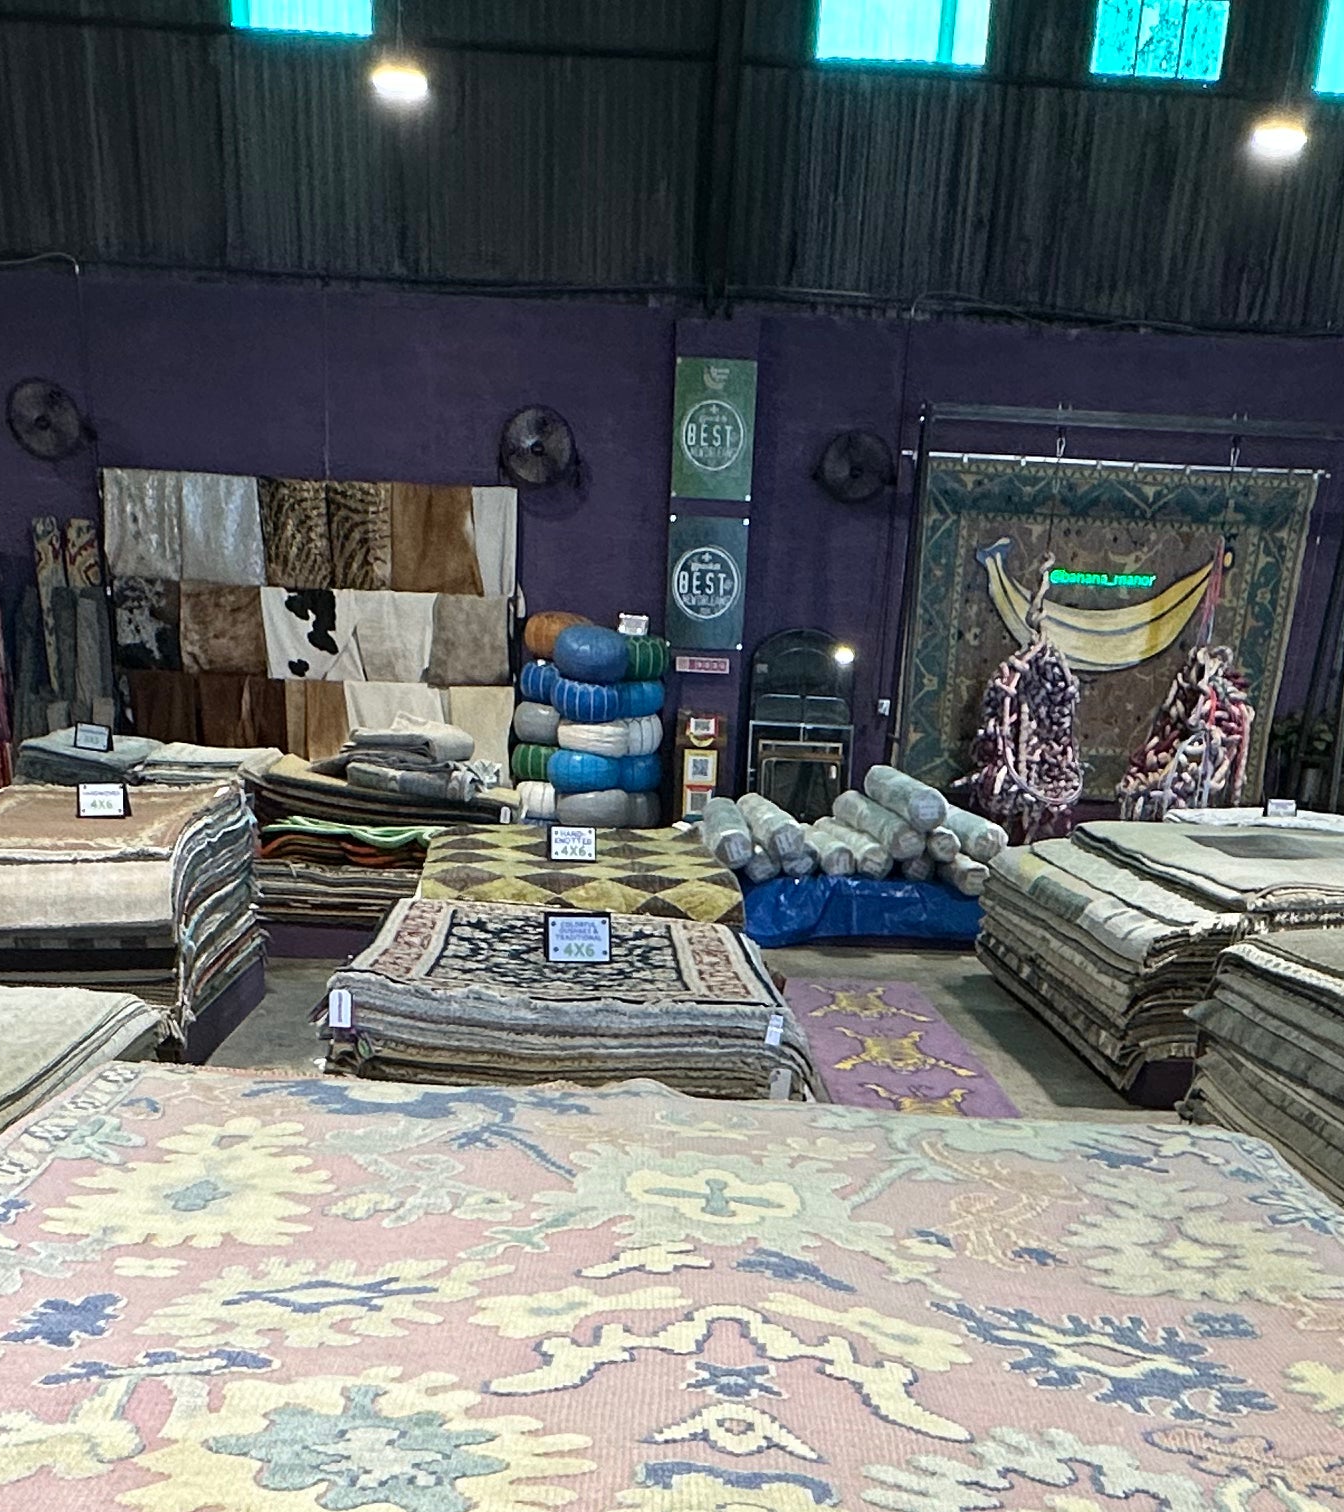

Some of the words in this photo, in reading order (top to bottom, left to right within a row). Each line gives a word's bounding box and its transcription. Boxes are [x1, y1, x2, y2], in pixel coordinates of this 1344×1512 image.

[687, 423, 733, 447] BEST
[679, 571, 726, 596] BEST
[1050, 569, 1156, 587] @banana_manor
[561, 846, 587, 857] 4X6
[563, 943, 595, 957] 4X6
